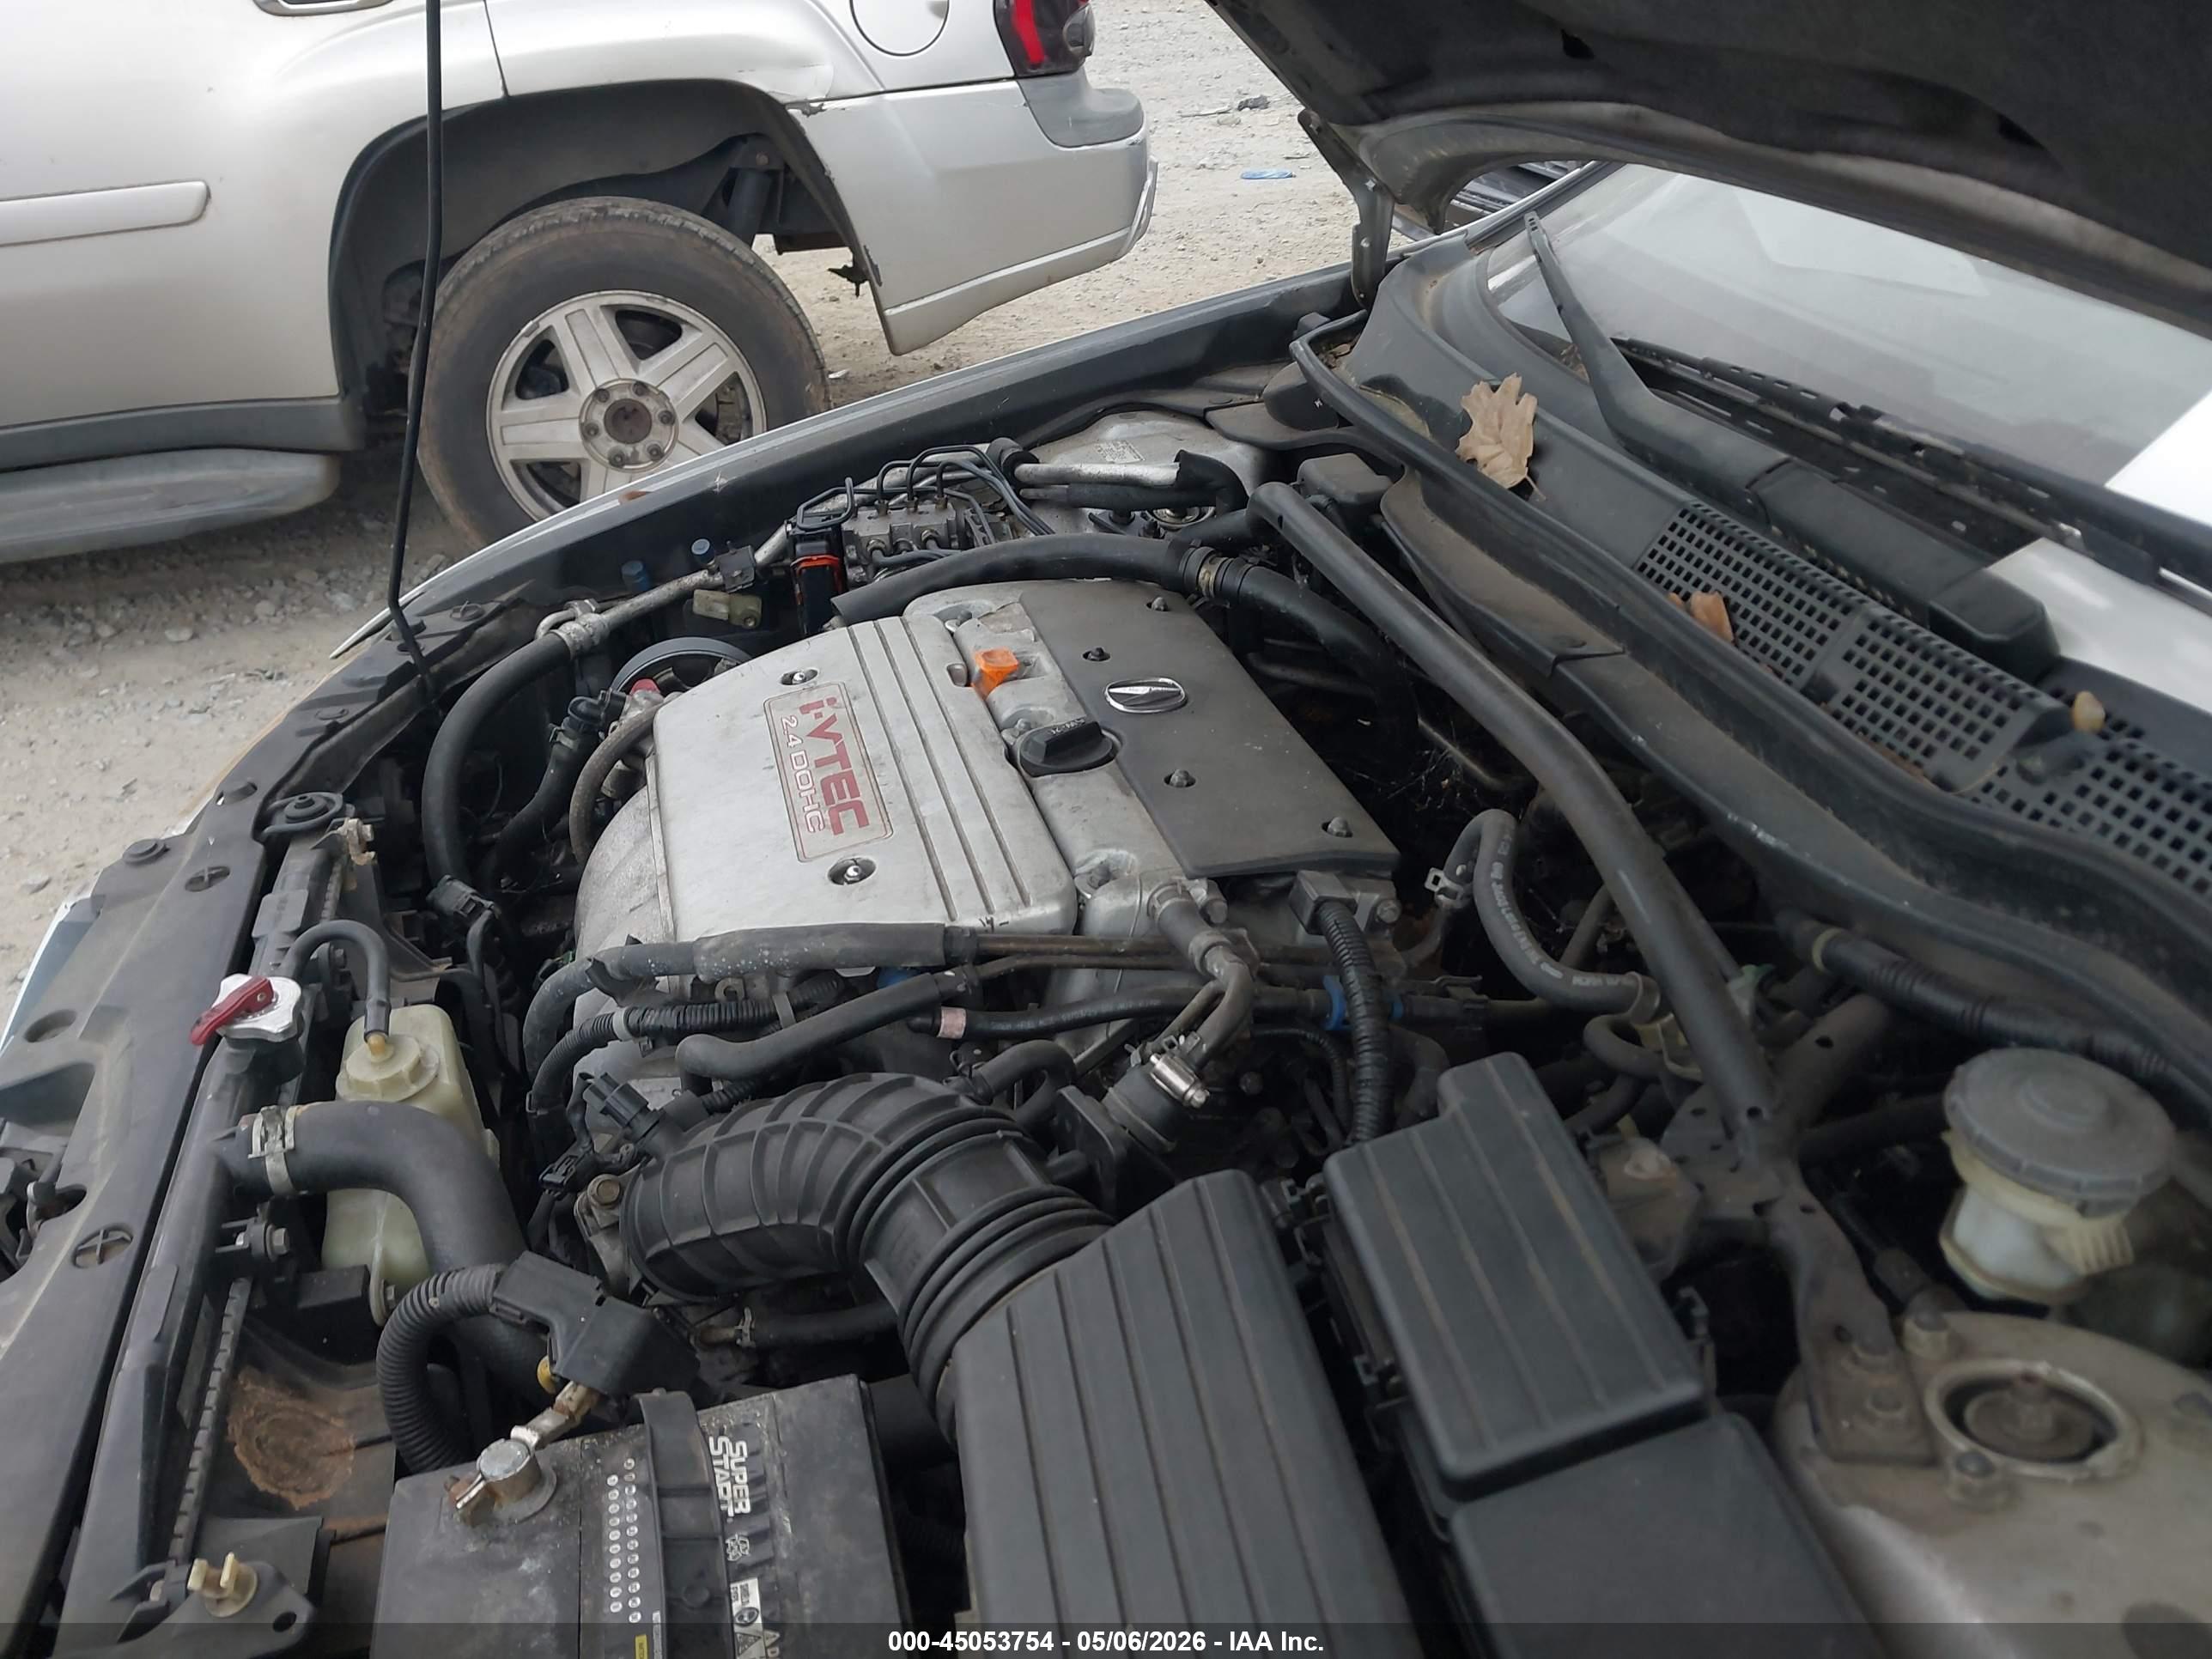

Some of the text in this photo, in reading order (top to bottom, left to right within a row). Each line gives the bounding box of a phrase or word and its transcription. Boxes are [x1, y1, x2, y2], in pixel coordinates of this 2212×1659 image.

[781, 714, 825, 833] 2.4 DOHC
[799, 697, 870, 836] i-VTEC
[708, 1435, 735, 1517] START
[728, 1440, 751, 1514] SUPER
